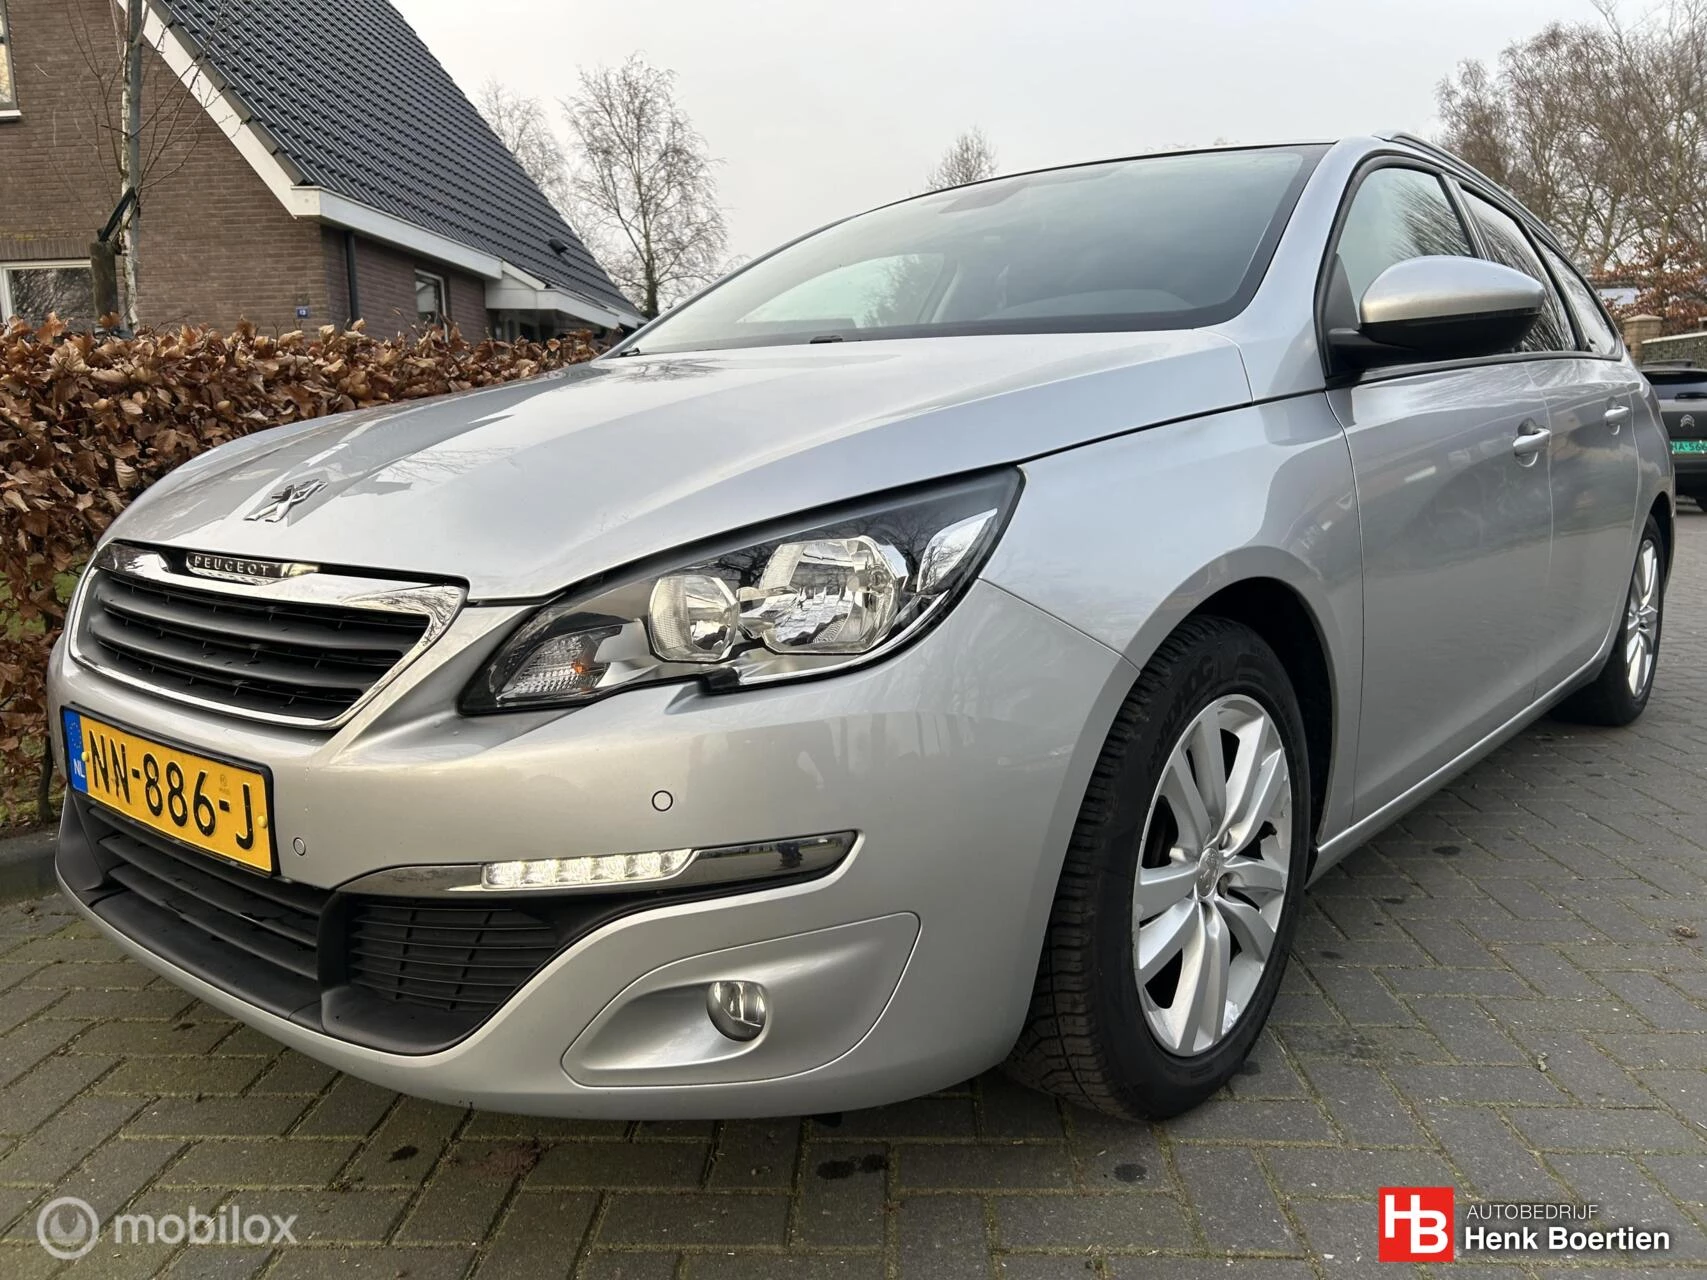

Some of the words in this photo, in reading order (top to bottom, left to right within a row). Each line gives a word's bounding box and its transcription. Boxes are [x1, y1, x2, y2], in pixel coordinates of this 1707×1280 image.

[193, 555, 270, 576] PEUGEOT
[73, 758, 86, 778] NL
[88, 729, 254, 850] NN-886-J
